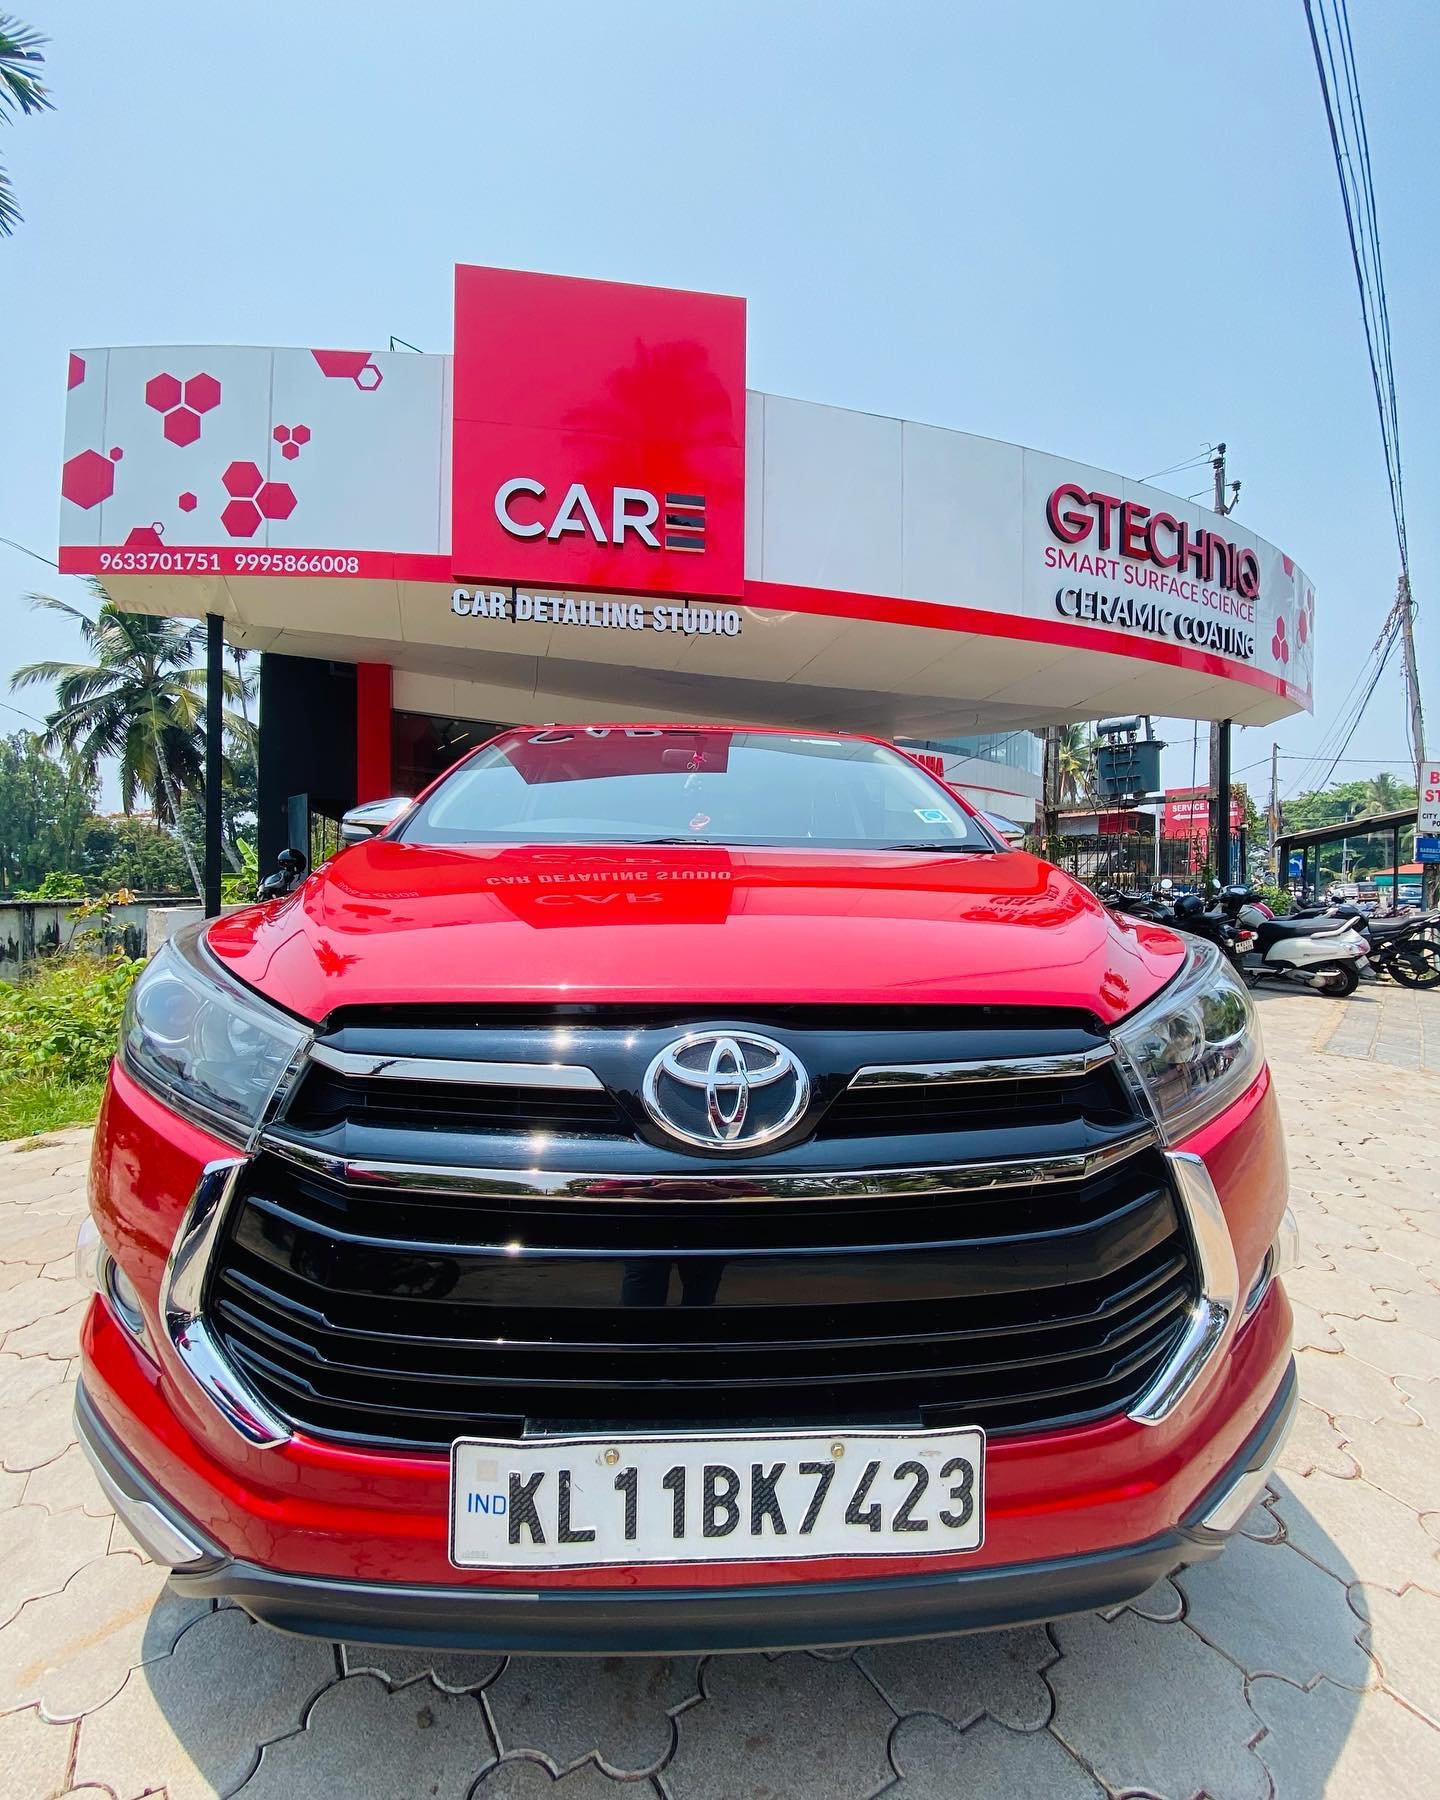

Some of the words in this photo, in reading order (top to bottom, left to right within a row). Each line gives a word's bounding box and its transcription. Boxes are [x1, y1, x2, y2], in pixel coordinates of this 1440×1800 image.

[493, 477, 706, 554] CARE
[101, 553, 221, 571] 9633701751
[234, 553, 360, 574] 9995866008
[1046, 483, 1260, 601] GTECHNIQ
[1044, 546, 1120, 581] SMART
[1123, 564, 1199, 602] SURFACE
[1201, 588, 1255, 624] SCIENCE
[452, 588, 507, 620] CAR
[515, 594, 644, 631] DETAILING
[652, 605, 740, 637] STUDIO
[1055, 584, 1175, 636] CERAMIC
[1172, 613, 1255, 660] COATING
[1172, 802, 1205, 813] SERVICE
[1422, 812, 1438, 820] CITY
[467, 1492, 507, 1515] IND
